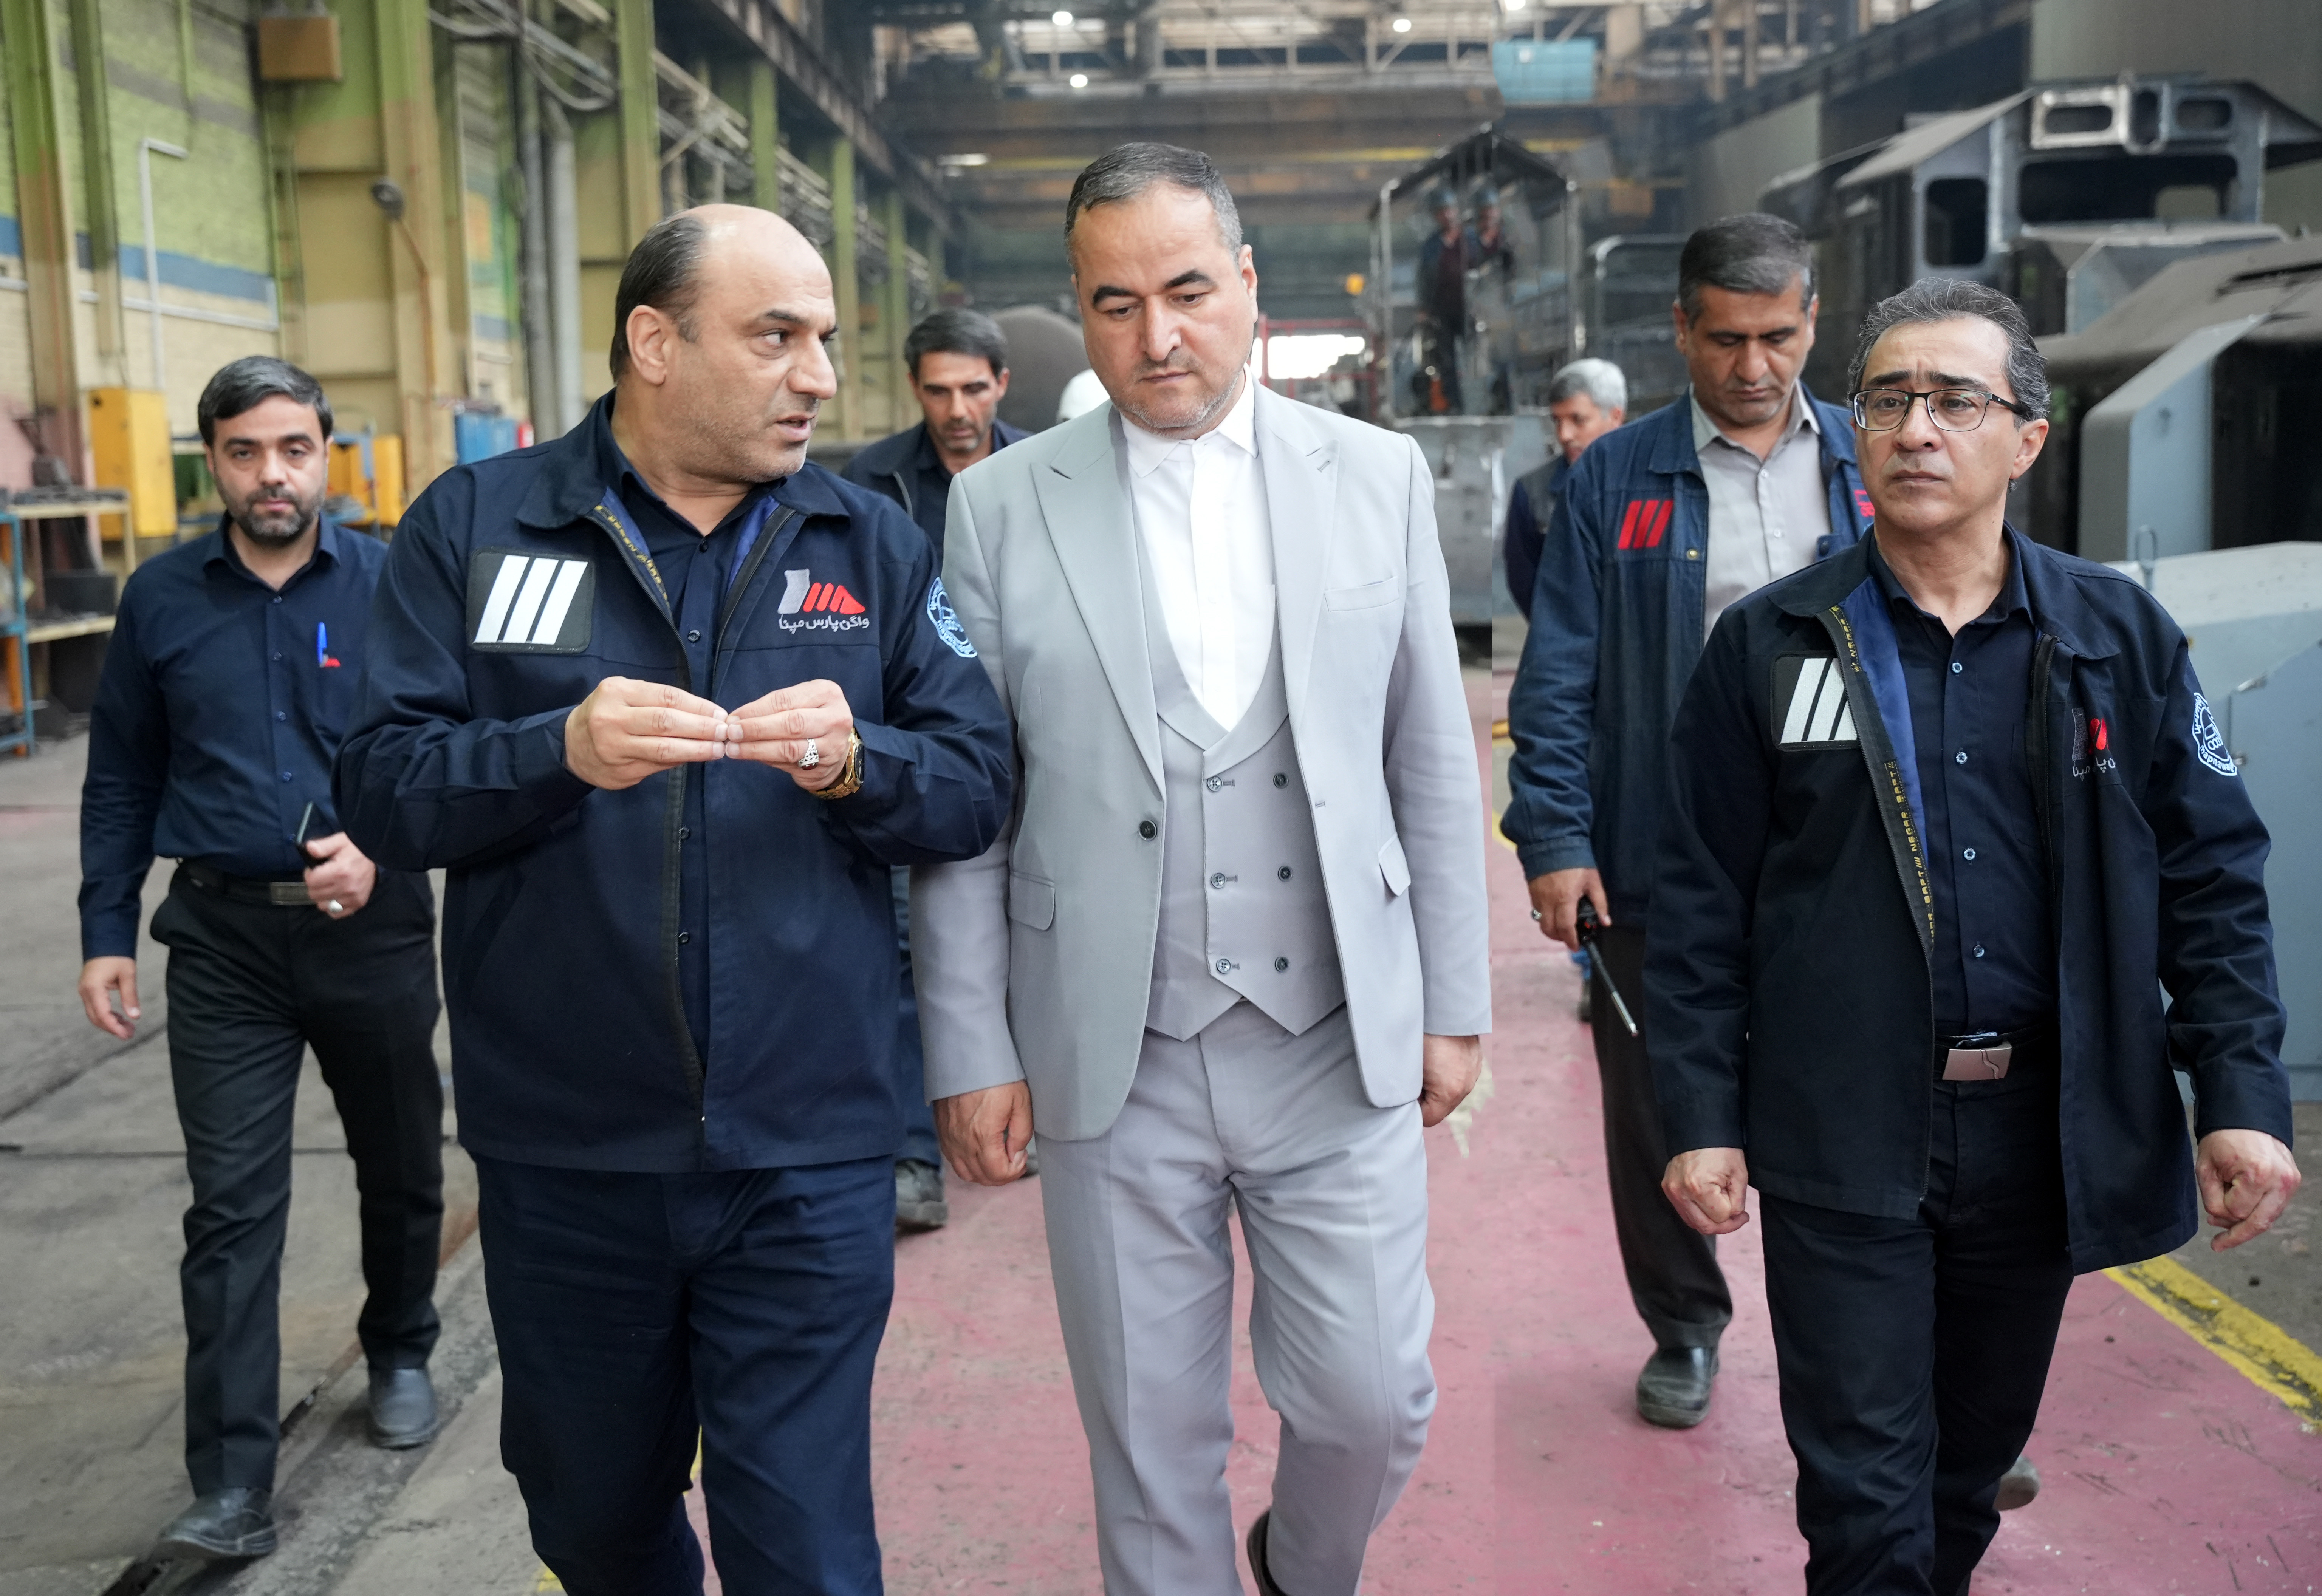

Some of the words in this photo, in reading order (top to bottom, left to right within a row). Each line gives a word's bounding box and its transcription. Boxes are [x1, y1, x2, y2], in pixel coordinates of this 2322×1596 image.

[779, 617, 804, 634] مپنا
[805, 615, 839, 632] پارس
[839, 615, 870, 630] واگن
